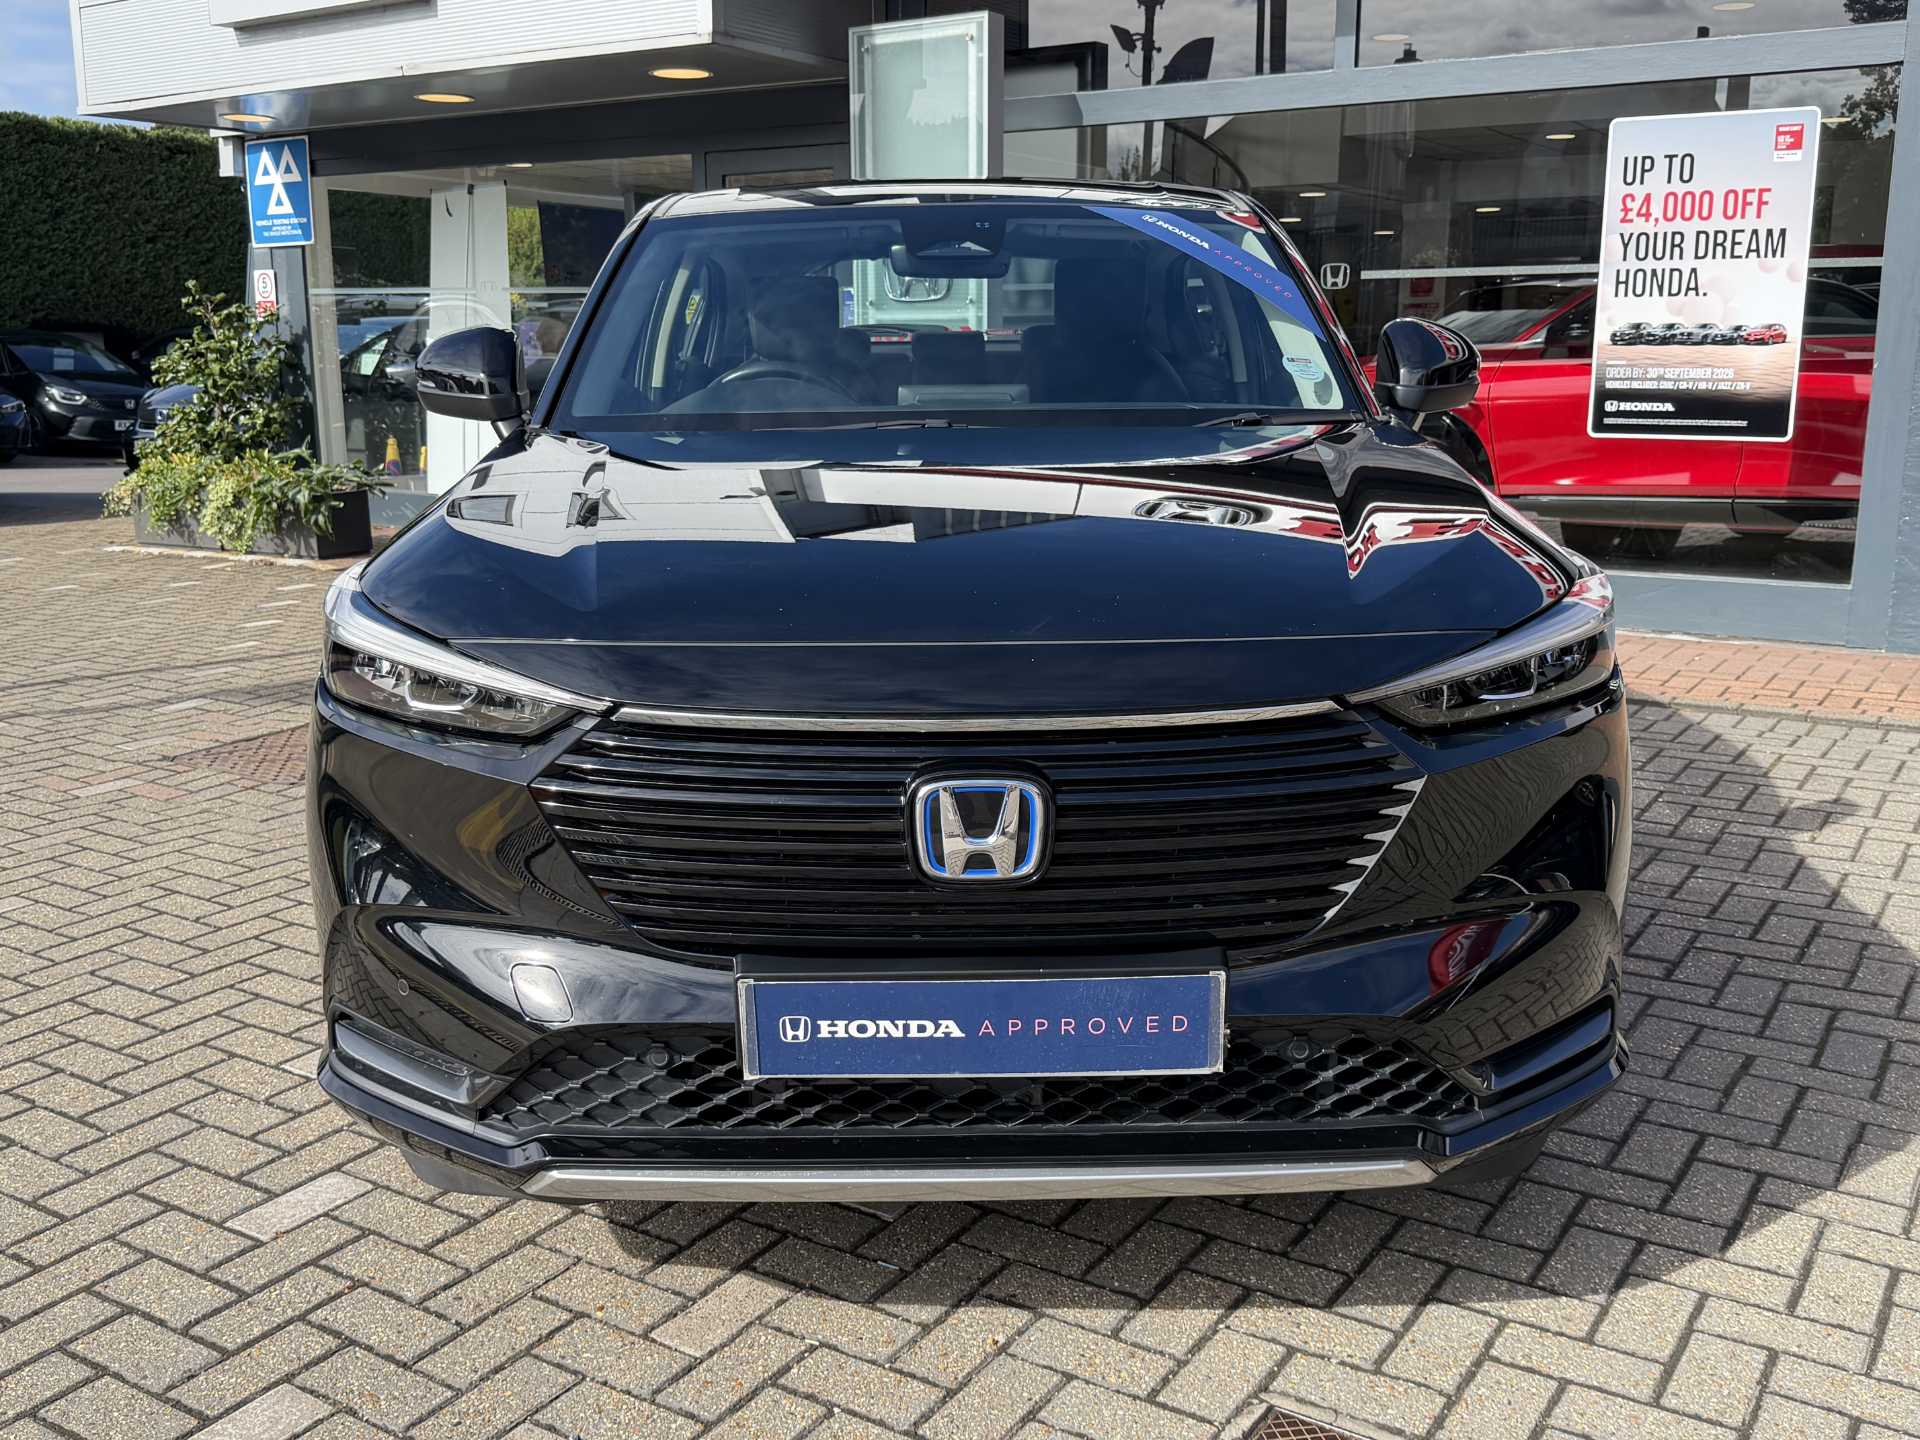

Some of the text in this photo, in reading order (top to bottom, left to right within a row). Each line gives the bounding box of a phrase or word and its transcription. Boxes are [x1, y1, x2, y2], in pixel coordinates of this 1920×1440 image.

[1623, 153, 1695, 186] UP TO
[1619, 188, 1772, 227] £4,000 OFF
[1156, 220, 1293, 299] HONDA APPROVED
[1619, 228, 1787, 261] YOUR DREAM
[1614, 268, 1708, 298] HONDA.
[1606, 367, 1631, 378] ORDER
[1664, 368, 1712, 379] SEPTEMBER
[1618, 402, 1675, 412] HONDA
[816, 1014, 1189, 1038] HONDA APPROVED
